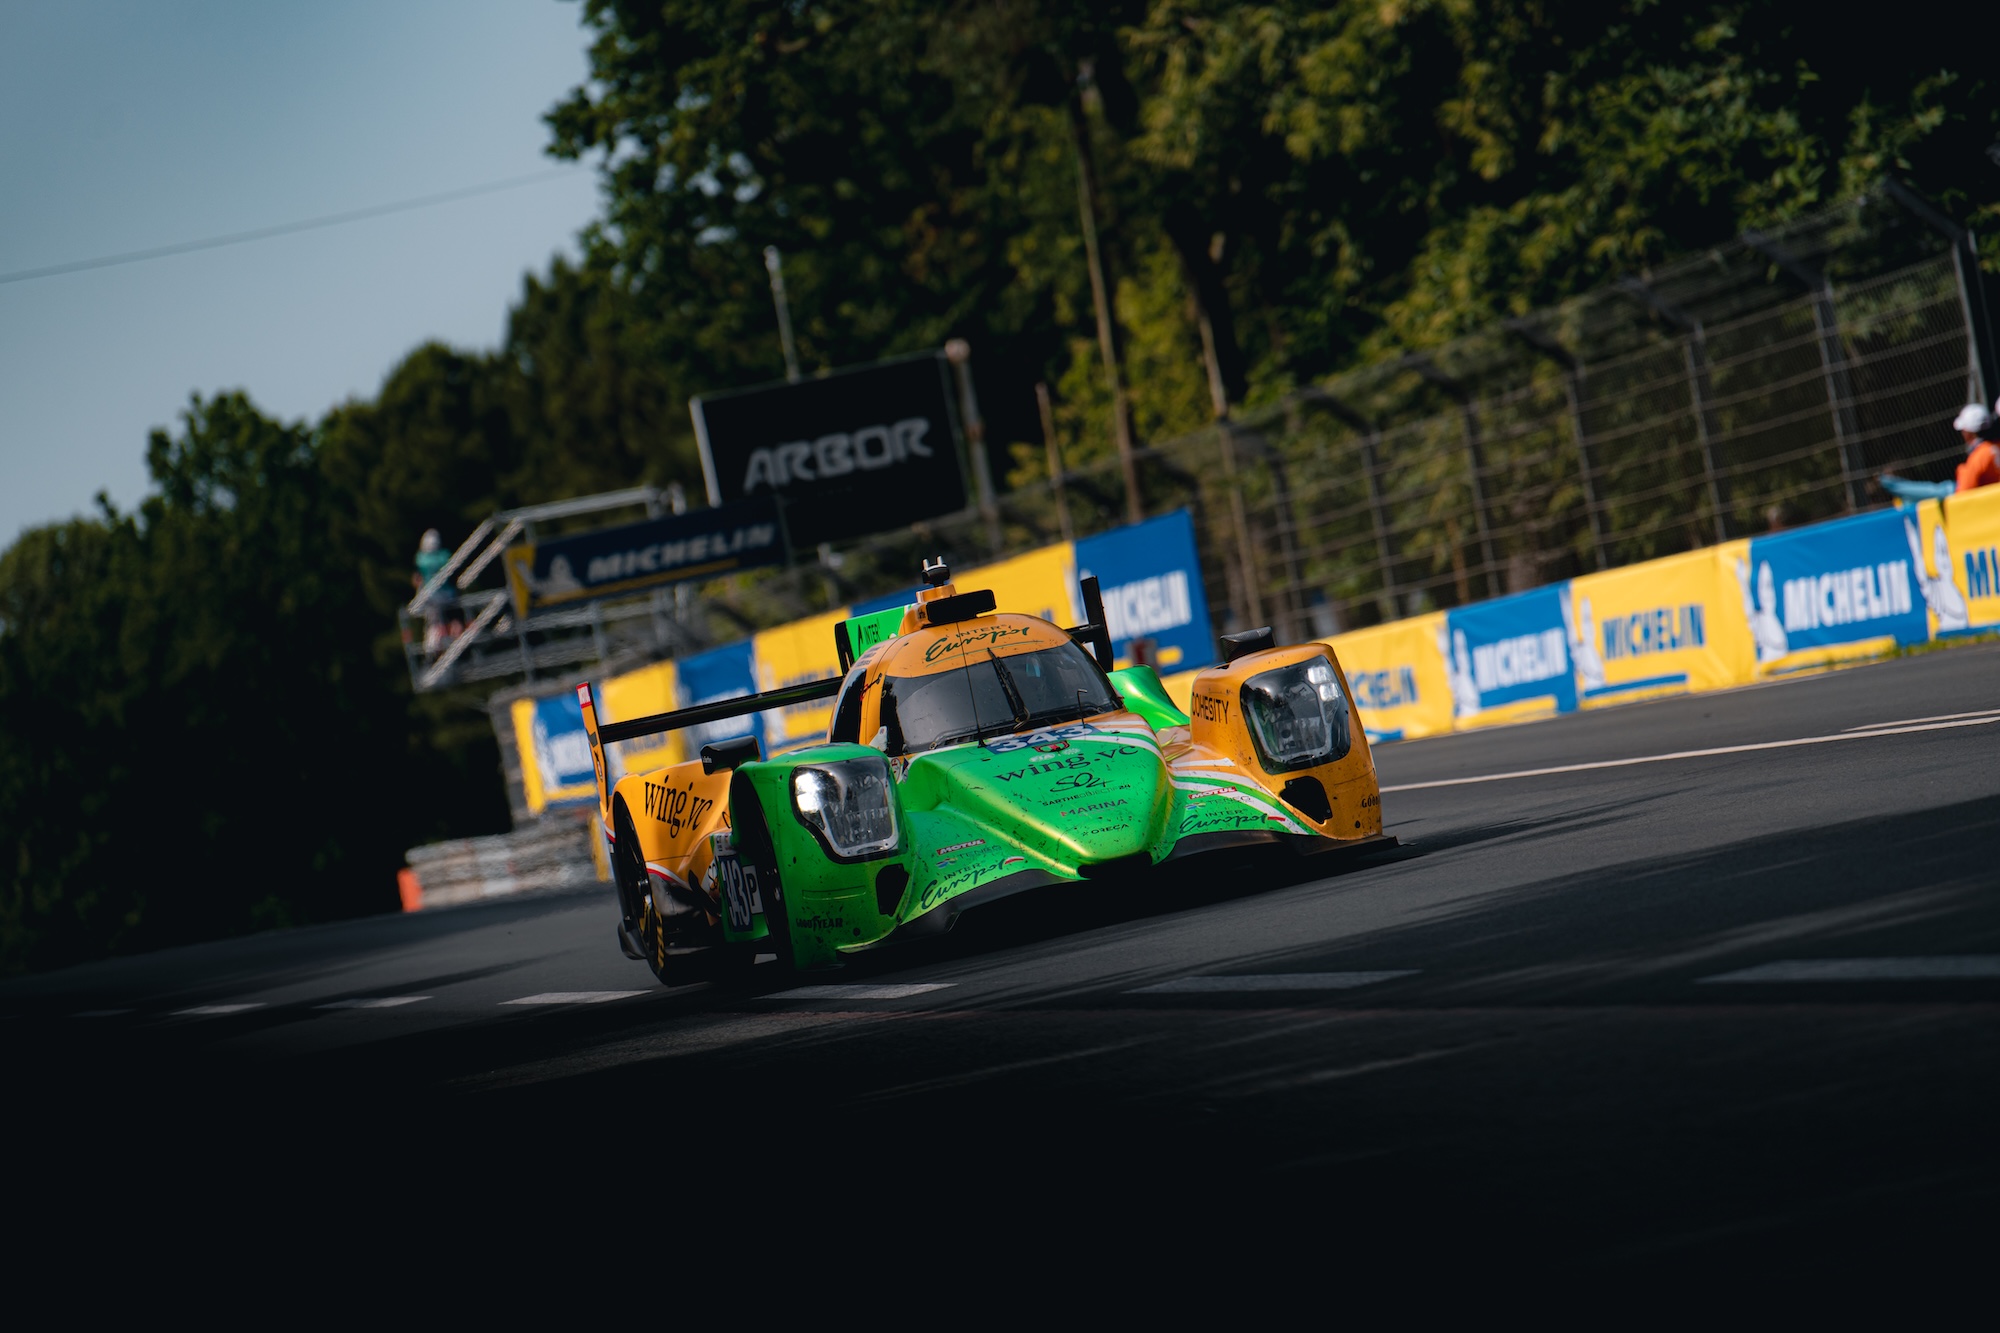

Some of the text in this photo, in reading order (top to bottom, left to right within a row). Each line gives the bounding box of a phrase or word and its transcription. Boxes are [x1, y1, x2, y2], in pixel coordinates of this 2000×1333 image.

[744, 416, 934, 493] ARBOR
[587, 524, 775, 583] MICHELIN
[1783, 558, 1912, 632] MICHELIN
[955, 624, 1002, 639] INTER
[1602, 604, 1704, 661] MICHELIN
[1472, 627, 1568, 692] MICHELIN
[1192, 692, 1229, 725] COHESITY
[991, 726, 1093, 753] 343
[995, 745, 1139, 782] wing.vc
[645, 774, 713, 838] wing.vc
[1191, 787, 1236, 799] MOTUL
[1180, 812, 1268, 834] Europol
[940, 839, 984, 854] MOTUL
[920, 858, 1007, 910] Europol
[944, 861, 981, 881] INTER
